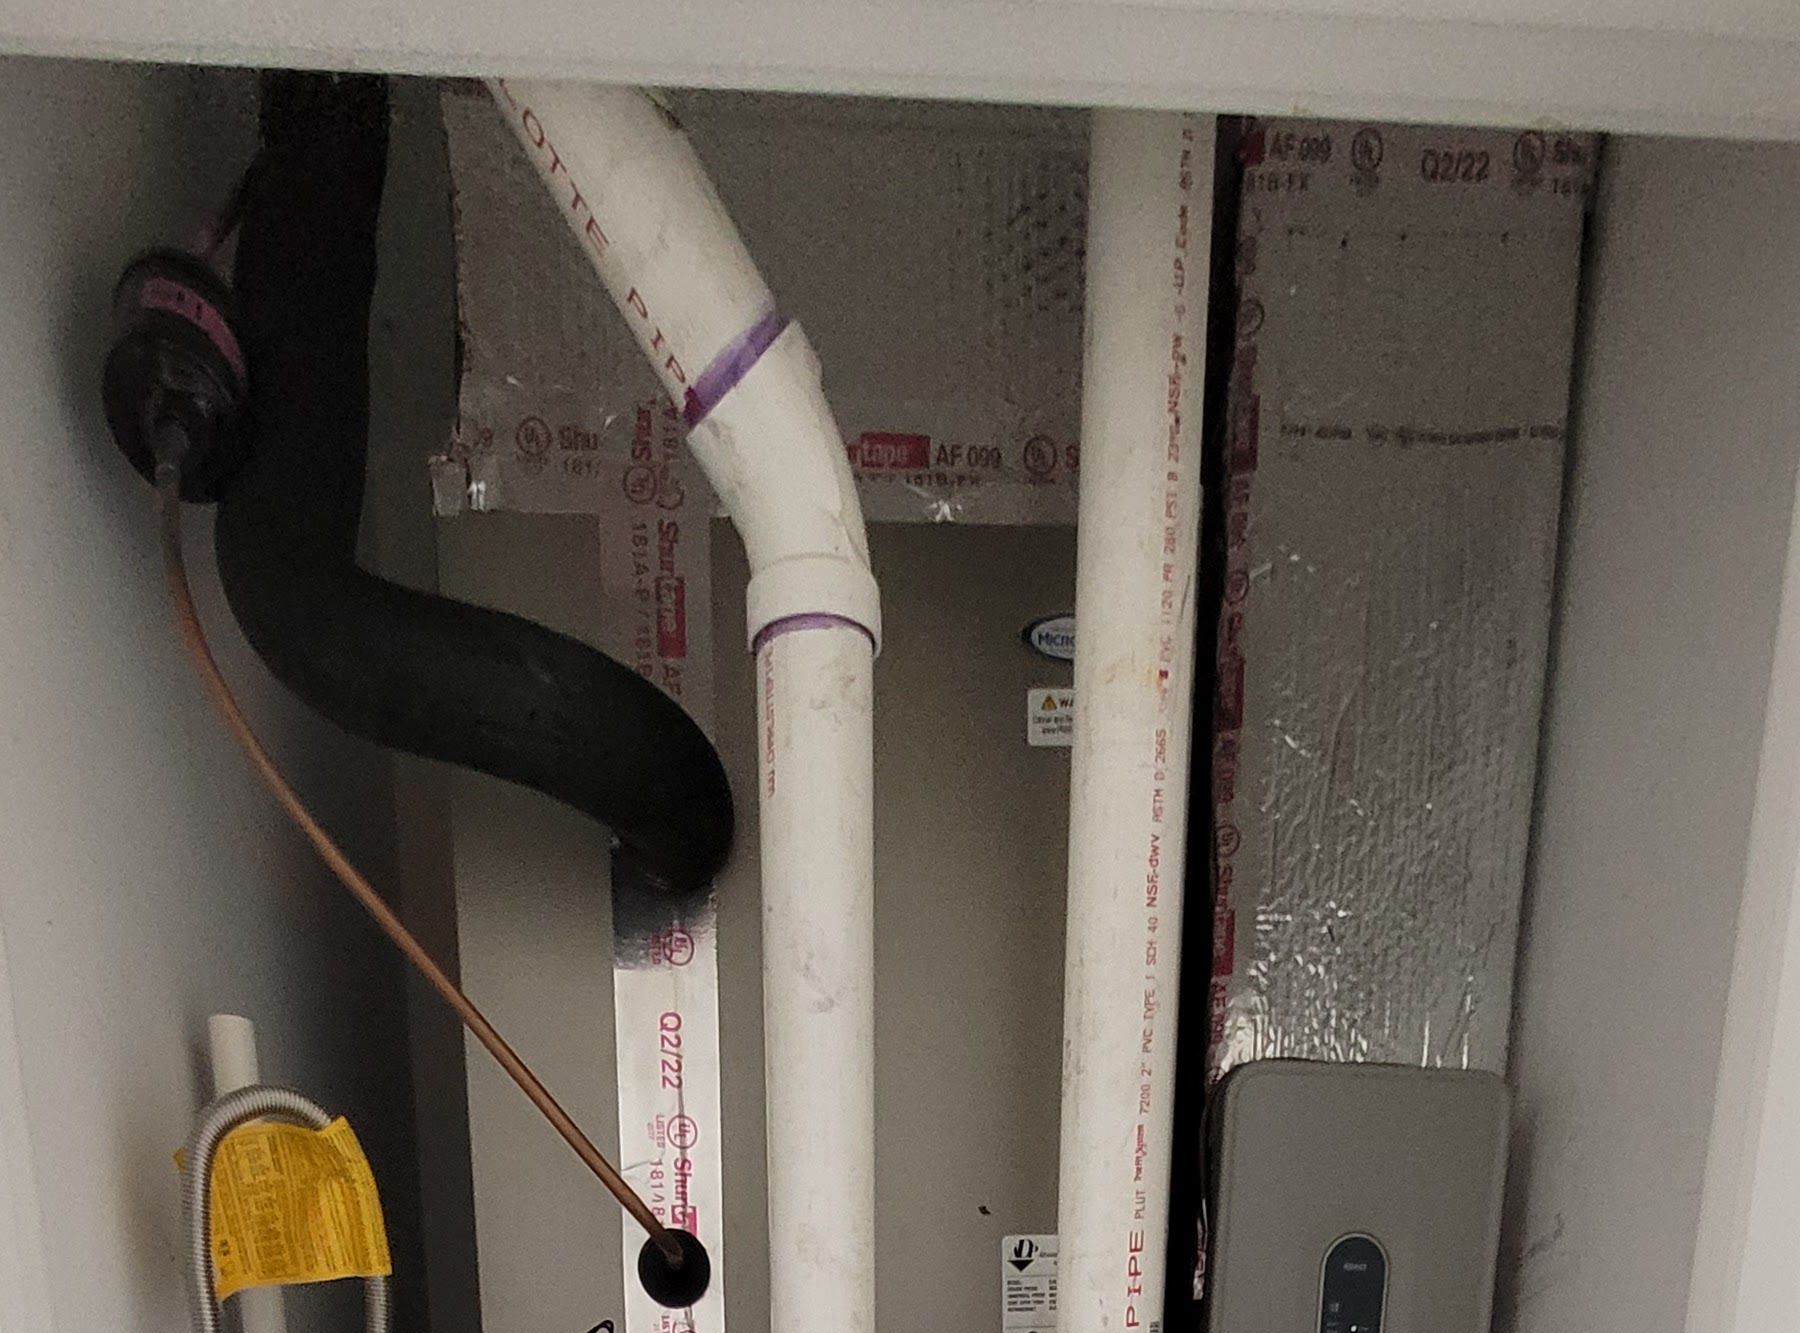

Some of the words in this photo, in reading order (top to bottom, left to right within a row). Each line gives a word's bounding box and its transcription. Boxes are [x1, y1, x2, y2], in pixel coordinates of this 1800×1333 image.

[1155, 729, 1167, 764] 2665
[1151, 789, 1163, 823] ASTM
[1147, 916, 1158, 933] 40
[1146, 940, 1157, 966] SCH
[1143, 989, 1156, 1020] TYPE
[660, 1011, 683, 1089] Q2/22
[1142, 1029, 1153, 1054] PVC
[1138, 1084, 1150, 1115] 7200
[1125, 1230, 1144, 1327] PIPE
